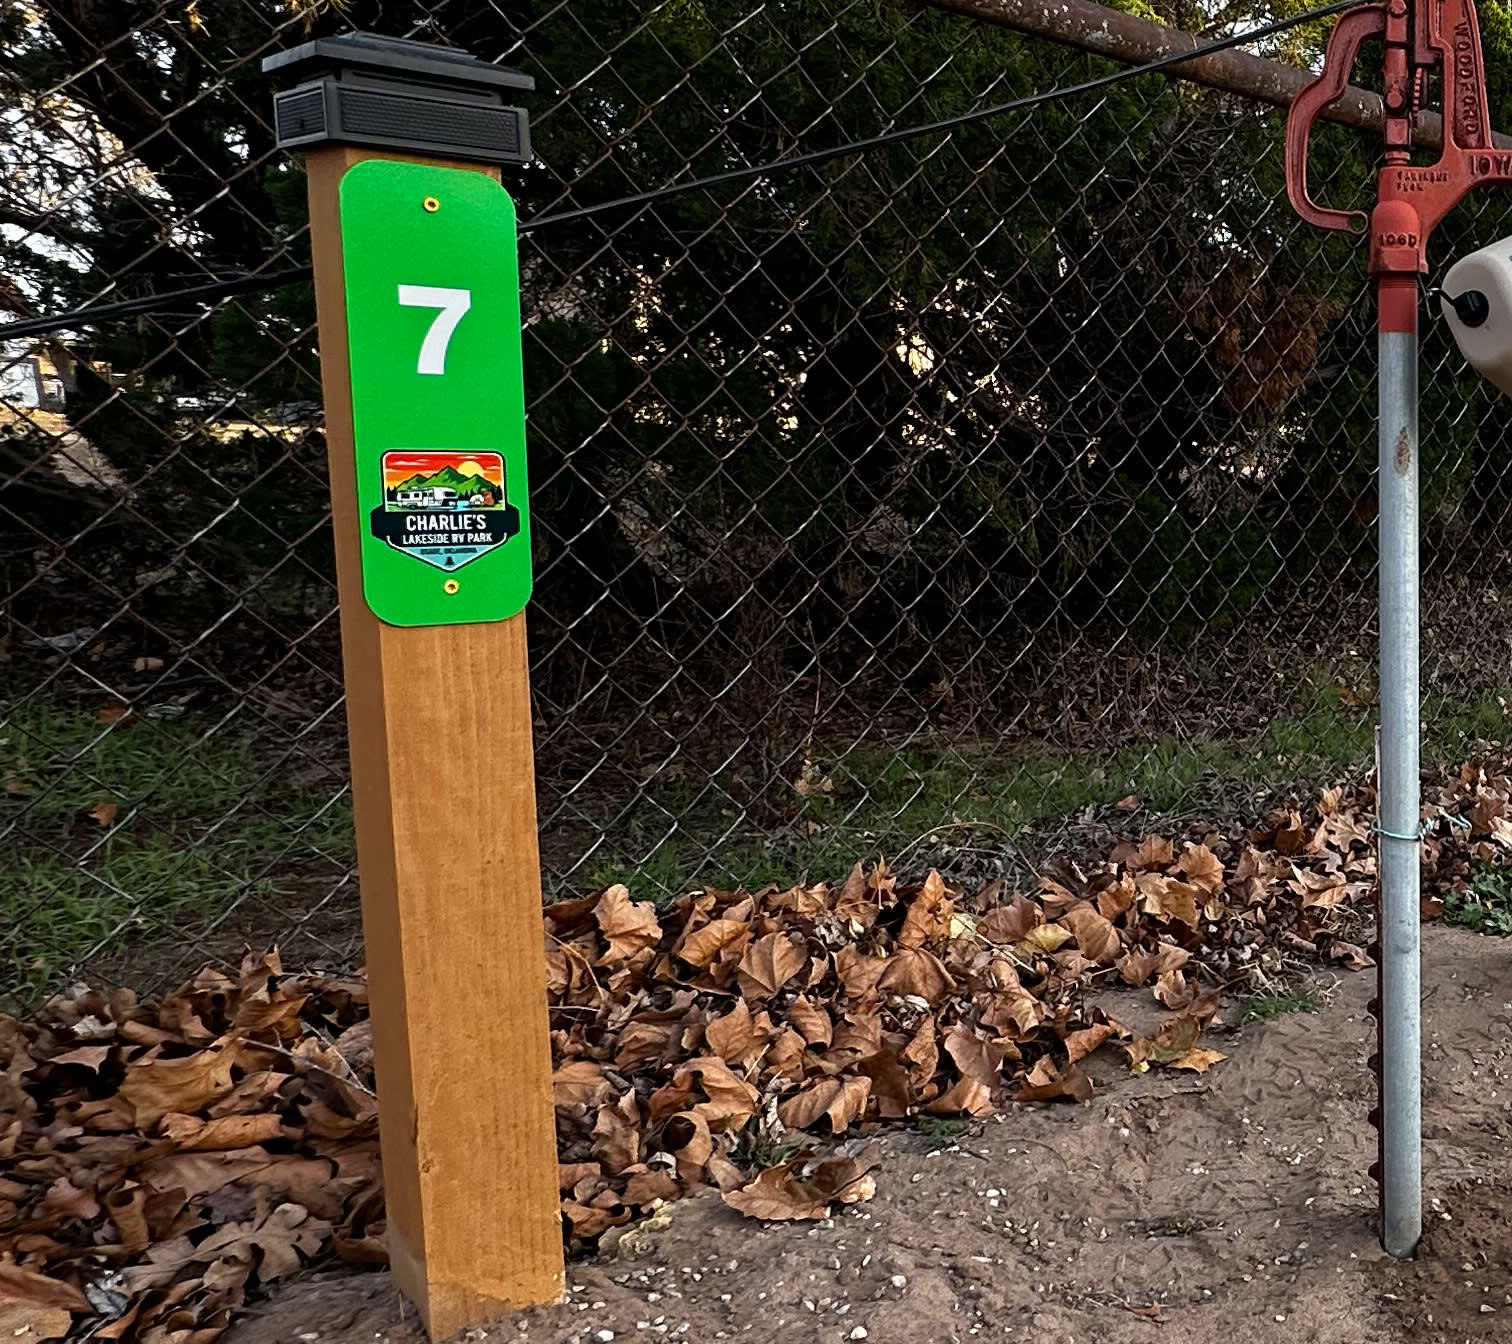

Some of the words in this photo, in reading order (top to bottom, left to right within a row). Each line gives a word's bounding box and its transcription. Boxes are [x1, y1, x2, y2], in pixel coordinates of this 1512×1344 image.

[1455, 22, 1480, 134] WOODFORD
[1380, 233, 1417, 248] 106D
[397, 283, 471, 375] 7
[405, 514, 487, 531] CHARLIE'S
[402, 533, 450, 545] LAKESIDE
[451, 532, 465, 543] RV
[467, 532, 493, 543] PARK
